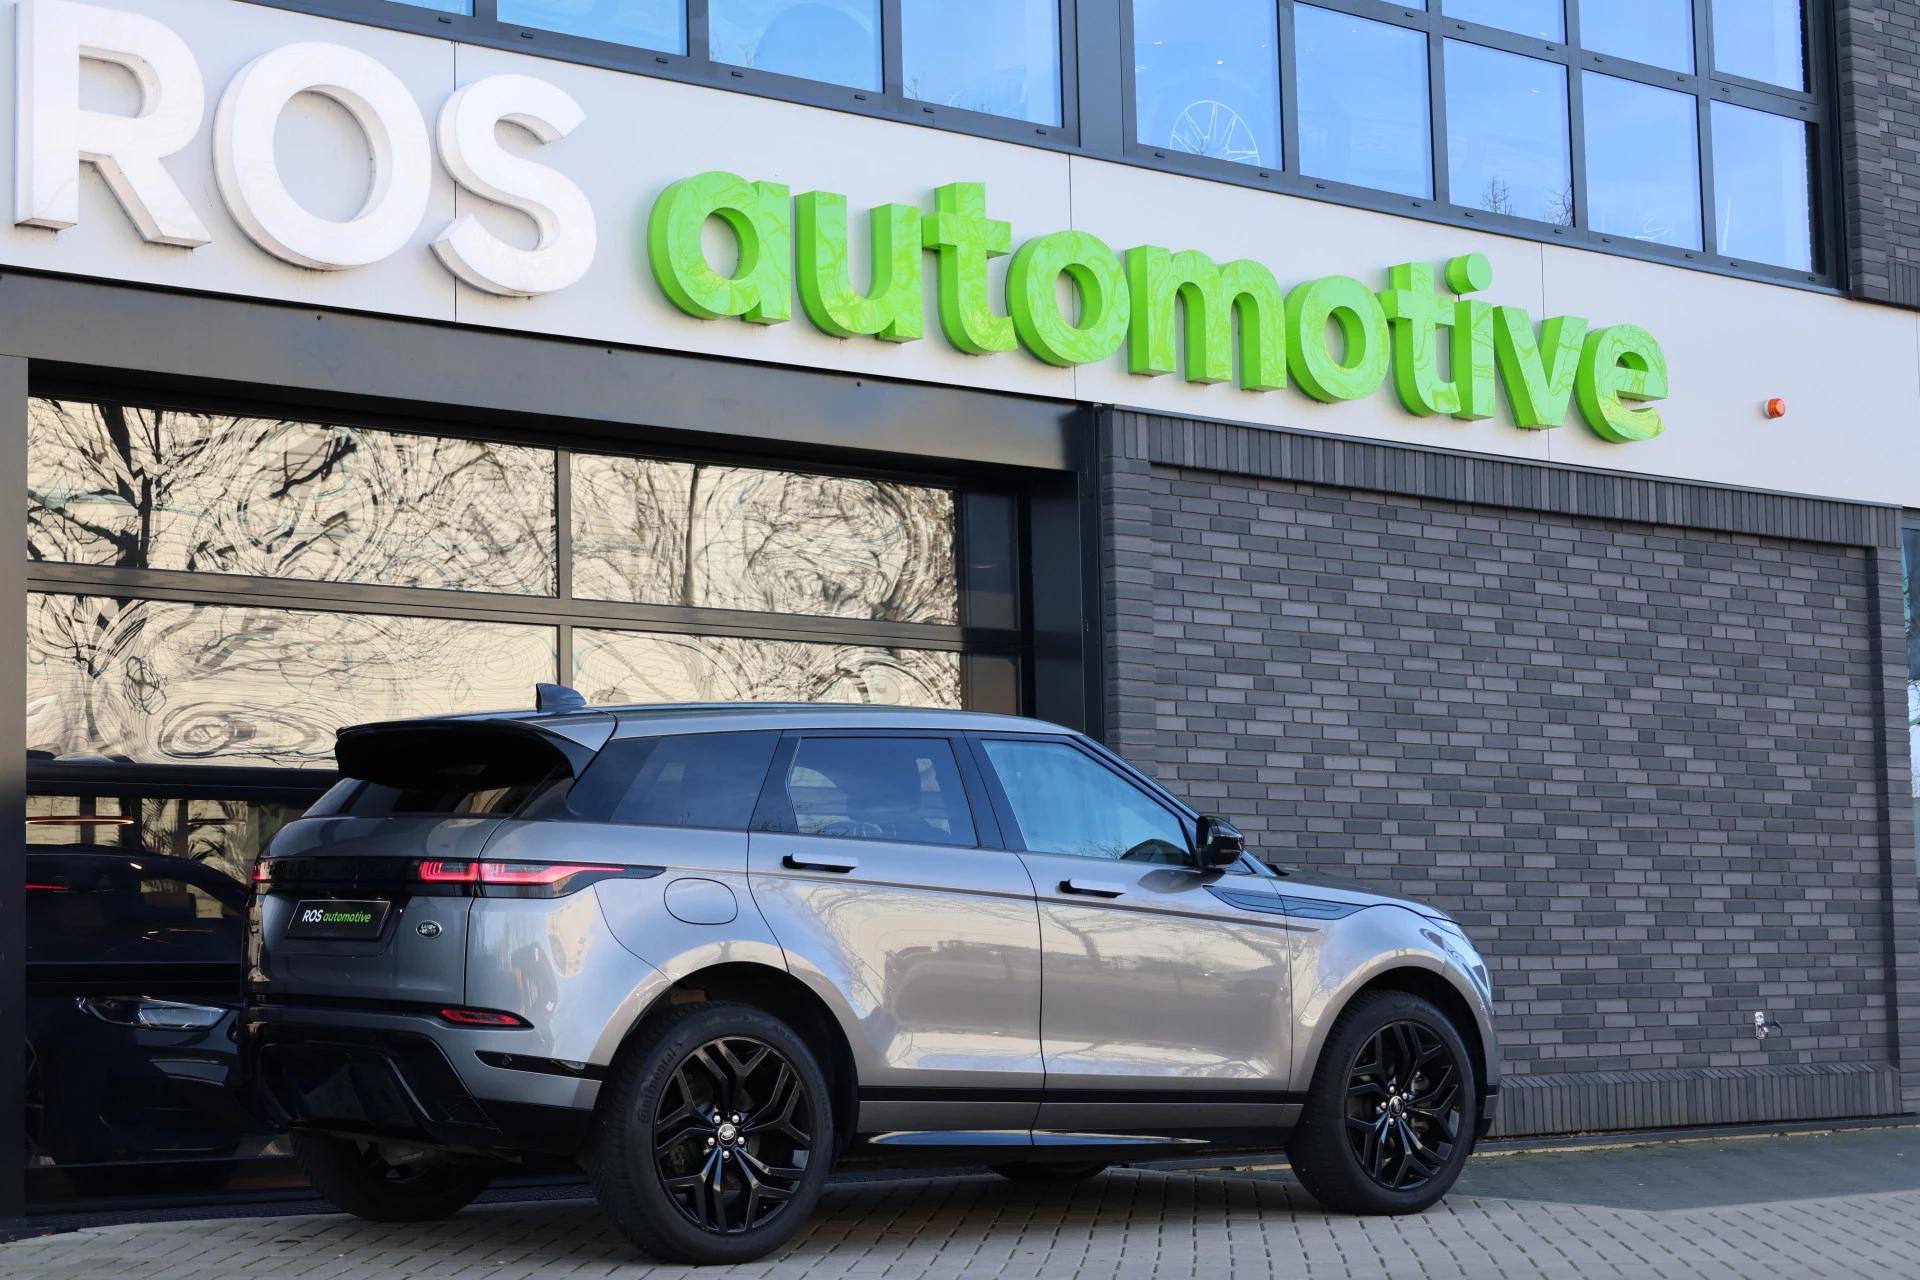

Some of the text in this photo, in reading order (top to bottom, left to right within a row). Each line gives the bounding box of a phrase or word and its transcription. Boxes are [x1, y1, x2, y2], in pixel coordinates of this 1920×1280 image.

[14, 0, 1668, 444] ROS automotive
[302, 909, 372, 922] ROS automotive
